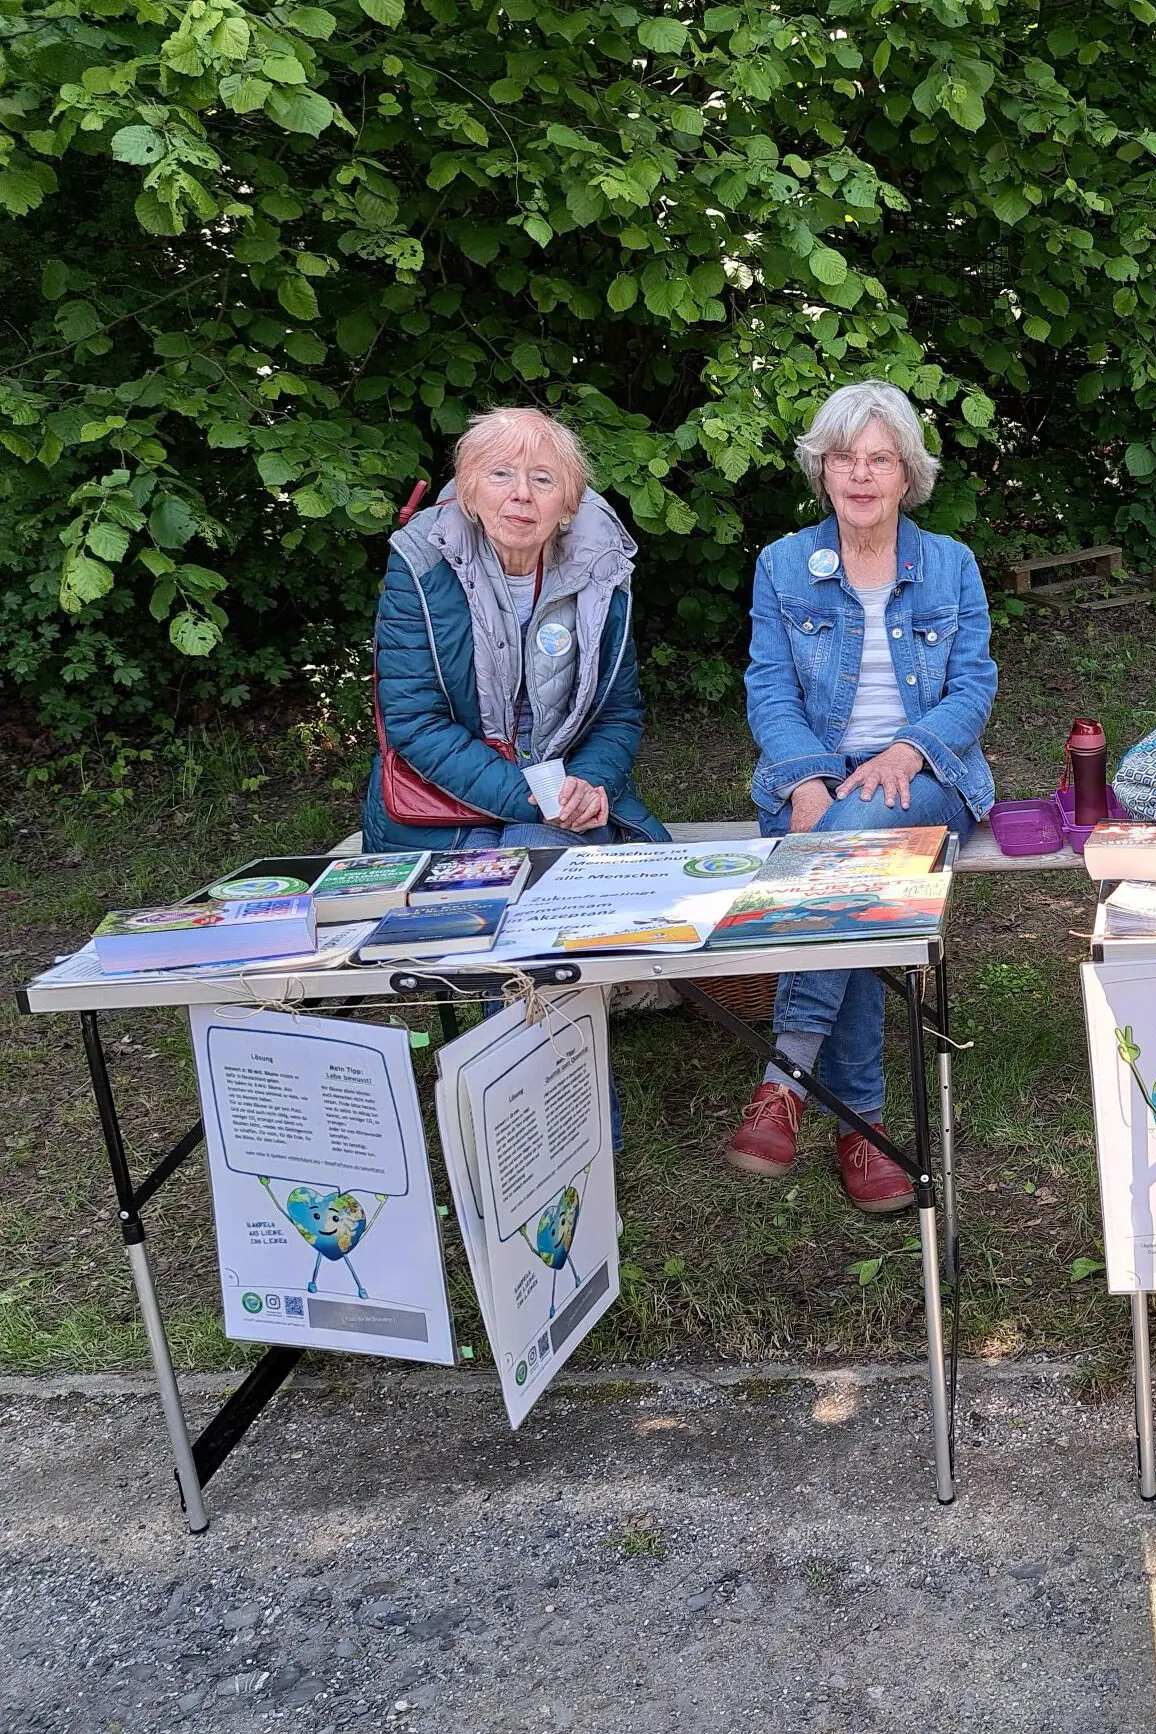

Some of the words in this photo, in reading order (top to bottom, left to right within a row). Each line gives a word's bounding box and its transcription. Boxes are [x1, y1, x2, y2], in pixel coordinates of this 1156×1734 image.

[804, 887, 883, 896] WALD
[530, 894, 595, 902] Zukunft
[513, 903, 613, 917] gemeinsam
[527, 910, 617, 922] Akzeptanz
[251, 1054, 273, 1063] Lösung
[347, 1067, 363, 1075] Tipp:
[508, 1088, 524, 1103] Lösung
